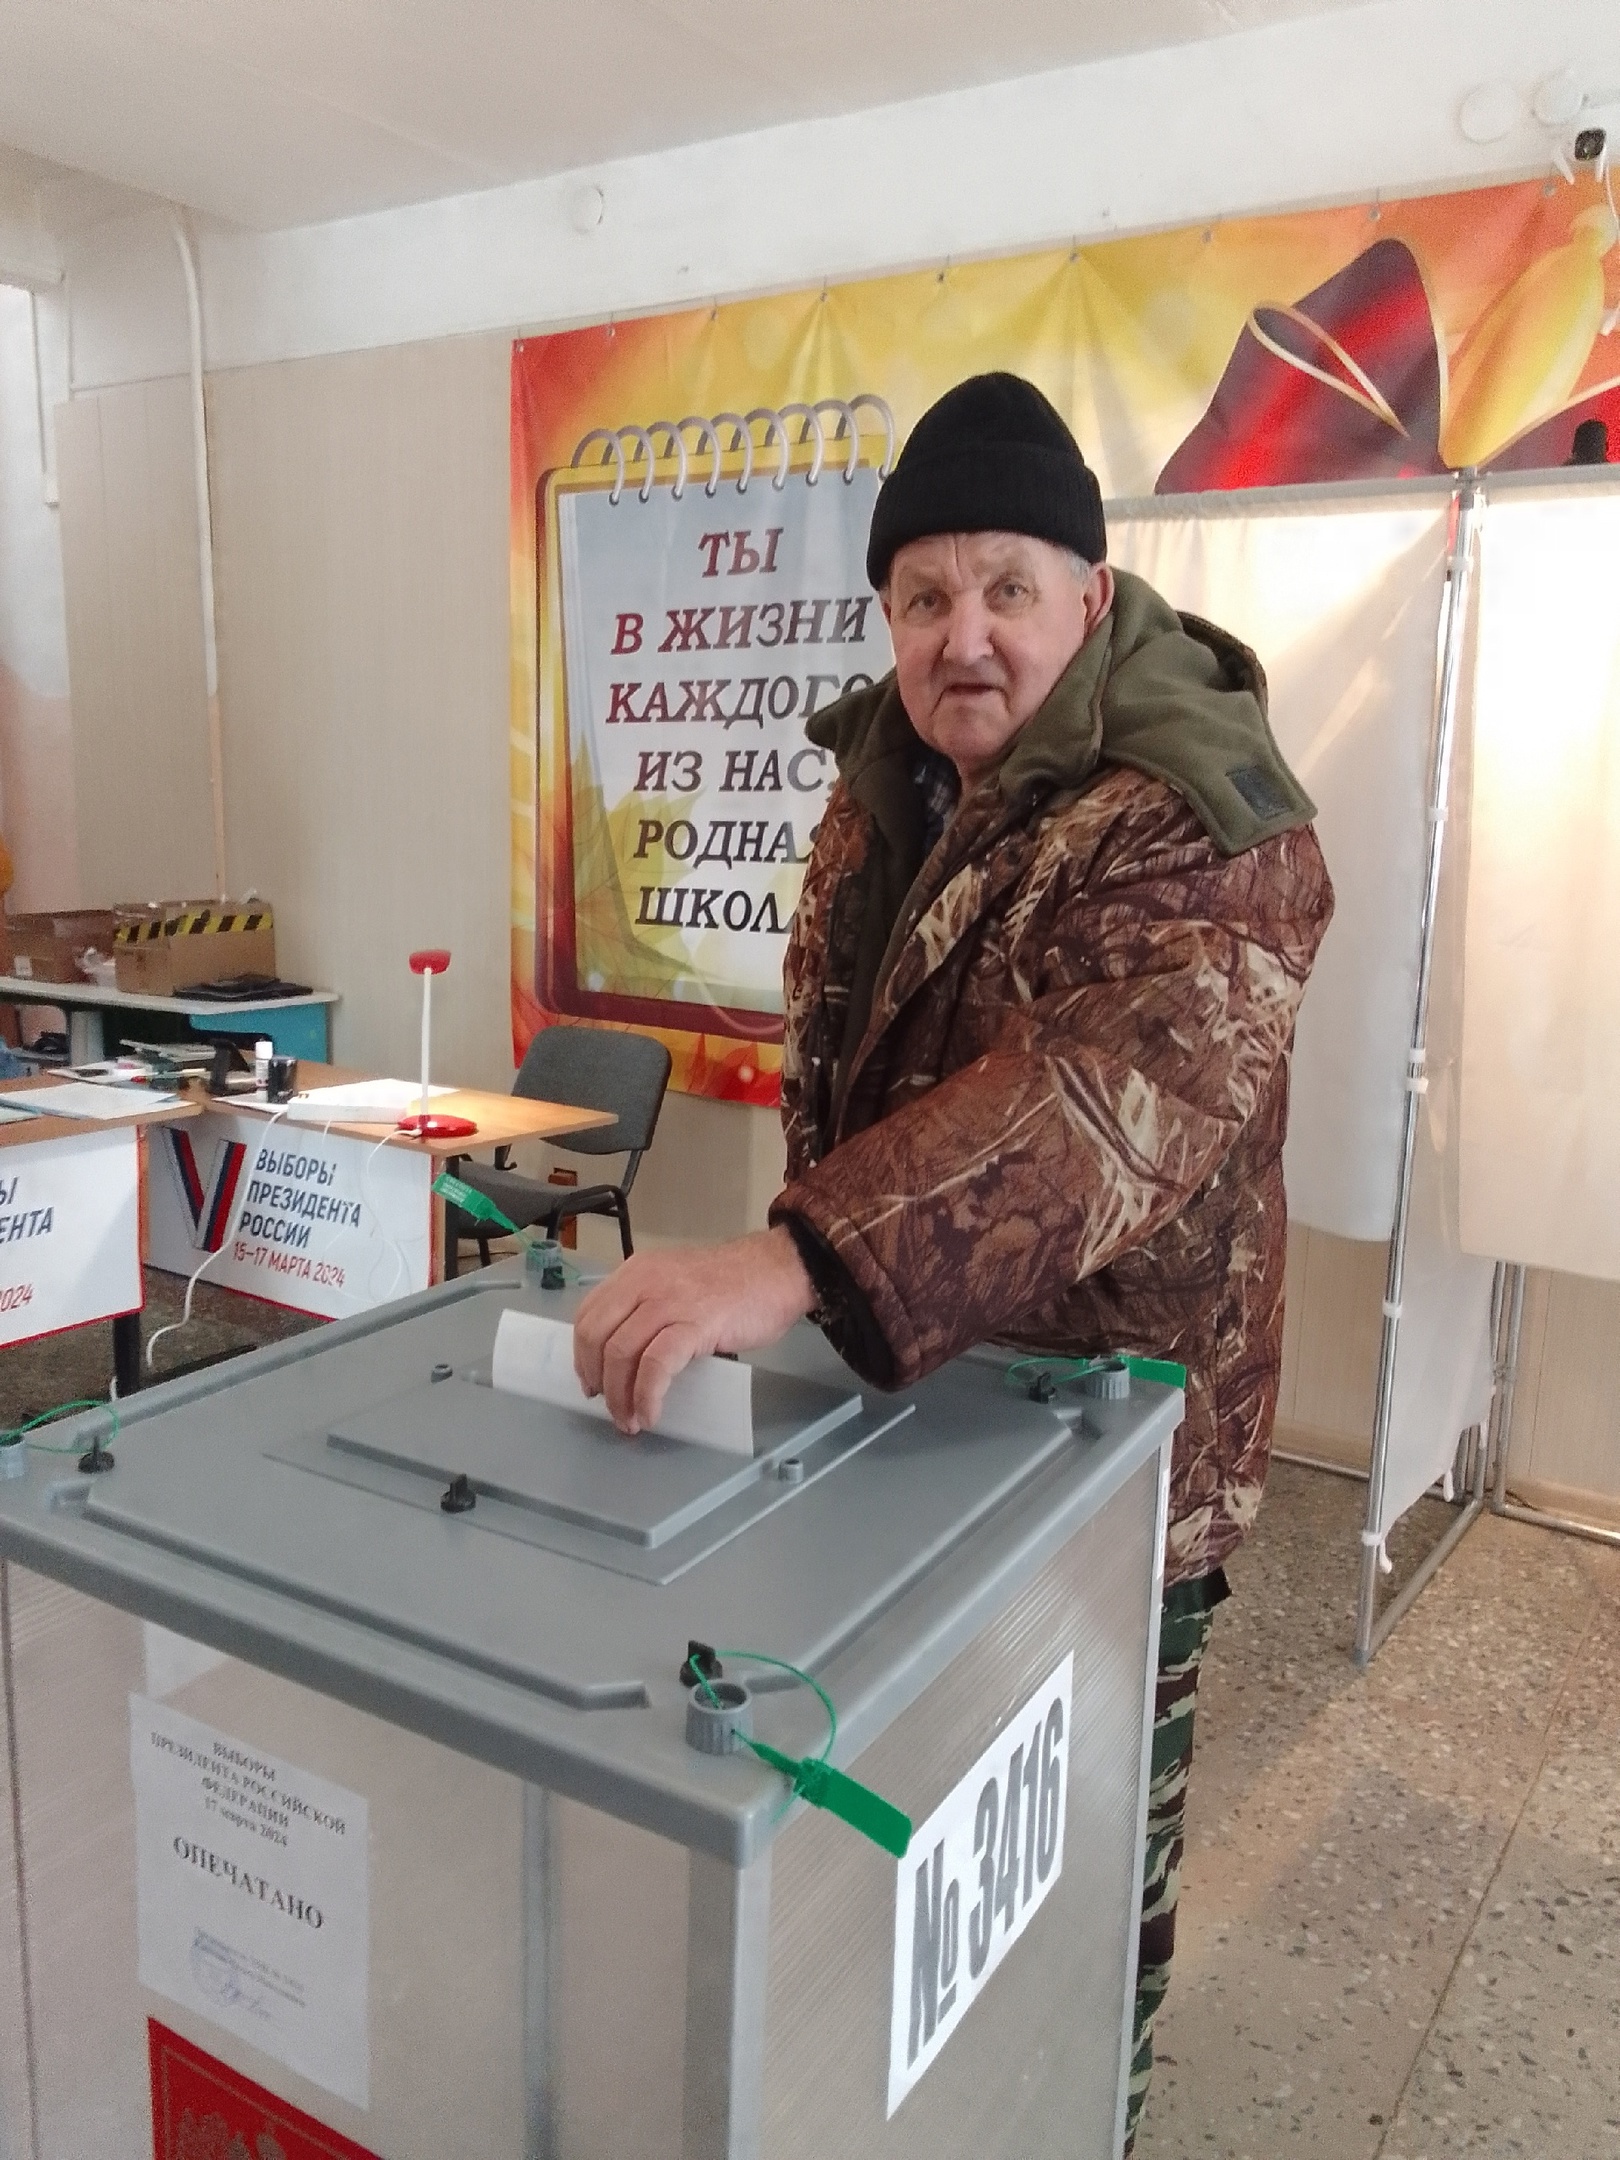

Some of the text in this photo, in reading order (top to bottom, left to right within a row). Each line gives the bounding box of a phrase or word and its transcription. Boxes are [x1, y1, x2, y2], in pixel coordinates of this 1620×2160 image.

[698, 528, 784, 578] ТЫ
[610, 596, 873, 655] В ЖИЗНИ
[633, 750, 701, 794] ИЗ
[635, 885, 799, 935] ШКОЛ
[255, 1148, 337, 1186] ВЫБОРЫ
[246, 1180, 362, 1228] ПРЕЗИДЕНТА
[238, 1211, 312, 1249] РОССИИ
[267, 1250, 313, 1279] МАРТА
[312, 1262, 346, 1288] 2024
[150, 1731, 347, 1836] ПРЕЗИДЕНТА РОССИЙСКОЙ
[213, 1741, 276, 1782] ВЫБОРЫ
[201, 1777, 289, 1828] ФЕДЕРАЦИИ
[173, 1836, 325, 1930] ОПЕЧАТАНО
[907, 1697, 1063, 2071] № 3416
